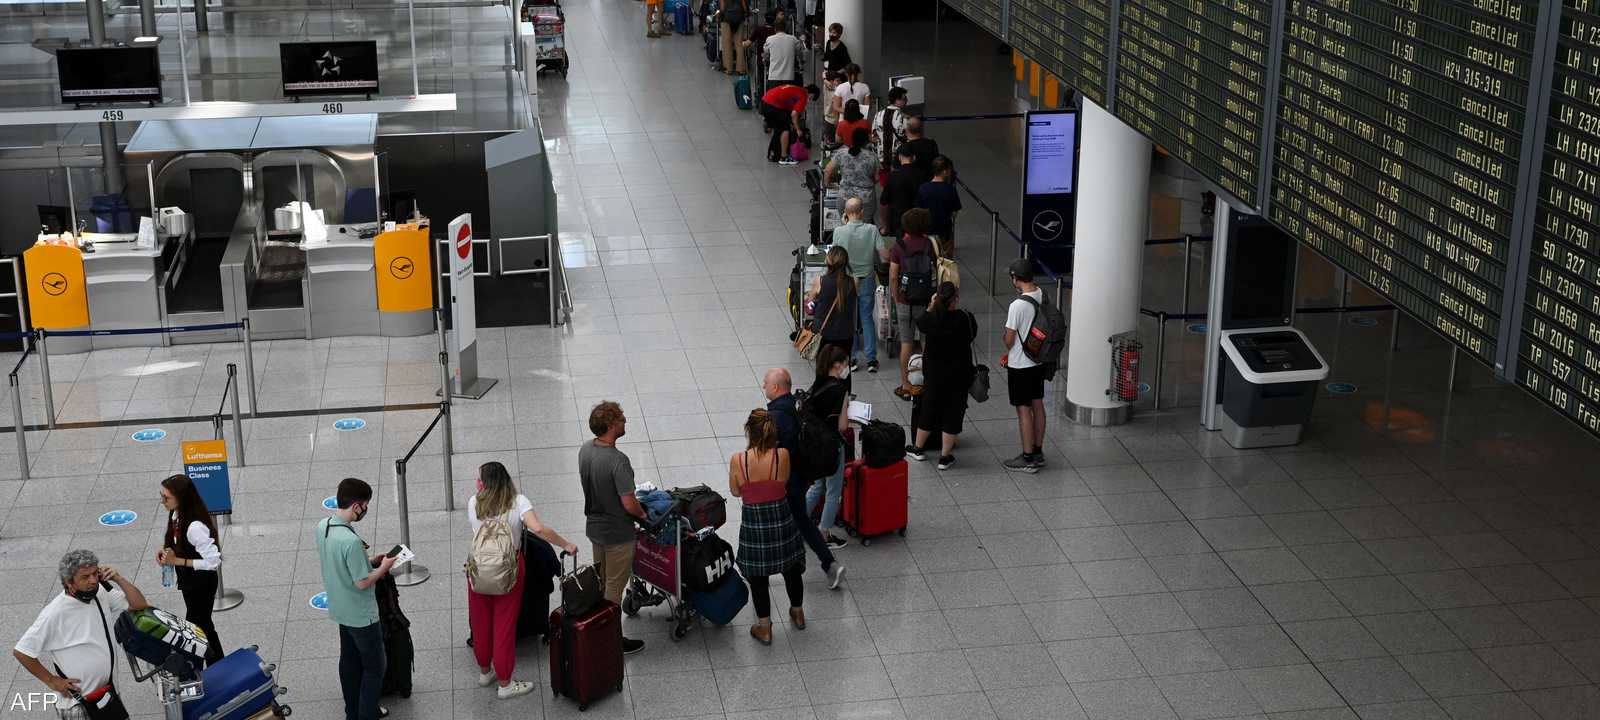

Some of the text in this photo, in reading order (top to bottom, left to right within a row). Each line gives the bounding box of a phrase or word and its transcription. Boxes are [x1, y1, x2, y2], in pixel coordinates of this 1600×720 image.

[1474, 0, 1522, 21] cancelled
[1575, 0, 1588, 13] LH
[1395, 16, 1417, 38] 11:50
[1468, 46, 1515, 75] cancelled
[1470, 20, 1519, 48] cancelled
[1572, 20, 1585, 41] LH
[1324, 13, 1352, 37] Toronto
[1392, 40, 1414, 62] 11:50
[1444, 60, 1461, 81] H24
[1464, 67, 1501, 98] 315-319
[1568, 48, 1581, 70] LH
[1322, 35, 1346, 58] Venice
[1390, 63, 1412, 86] 11:50
[1461, 96, 1509, 128] cancelled
[1564, 77, 1577, 98] LH
[102, 110, 124, 121] 459
[322, 103, 343, 114] 460
[1320, 58, 1348, 81] Houston
[1387, 87, 1409, 110] 11:55
[1458, 122, 1506, 153] cancelled
[1560, 104, 1574, 126] LH
[1300, 92, 1311, 110] 105
[1316, 100, 1350, 131] Frankfurt
[1382, 133, 1404, 158] 12:00
[1452, 171, 1500, 205] cancelled
[1319, 80, 1342, 102] Zagreb
[1384, 110, 1407, 134] 11:55
[1455, 147, 1503, 180] cancelled
[1557, 132, 1600, 167] LH 1814
[1314, 122, 1335, 144] Olbia
[1380, 156, 1402, 181] 12:00
[1450, 196, 1497, 230] cancelled
[1554, 160, 1597, 195] LH 714
[1312, 143, 1333, 166] Paris
[1377, 179, 1400, 204] 12:05
[1447, 216, 1494, 256] Lufthansa
[1550, 186, 1593, 224] LH 1944
[1308, 186, 1343, 219] Stockholm
[1373, 224, 1395, 251] 12:15
[1442, 265, 1488, 305] Lufthansa
[1375, 202, 1397, 226] 12:10
[1426, 230, 1442, 253] H18
[1446, 240, 1481, 274] 401-407
[1547, 213, 1589, 250] LH 1790
[1290, 196, 1302, 214] 107
[1307, 206, 1345, 242] Washington
[1370, 247, 1393, 273] 12:20
[1439, 292, 1485, 330] cancelled
[1543, 240, 1556, 262] SQ
[1566, 252, 1585, 276] 327
[1305, 226, 1324, 252] Delhi
[1368, 268, 1390, 295] 12:25
[1436, 315, 1482, 354] cancelled
[1540, 266, 1552, 289] LH
[1557, 276, 1582, 305] 2304
[1536, 292, 1549, 314] LH
[1554, 303, 1578, 332] 1868
[1533, 318, 1546, 340] LH
[1550, 329, 1575, 358] 2016
[1526, 370, 1539, 392] LH
[1550, 384, 1568, 410] 109
[1531, 344, 1600, 402] TP 557 Lis
[188, 464, 222, 472] Business
[704, 550, 732, 585] HH
